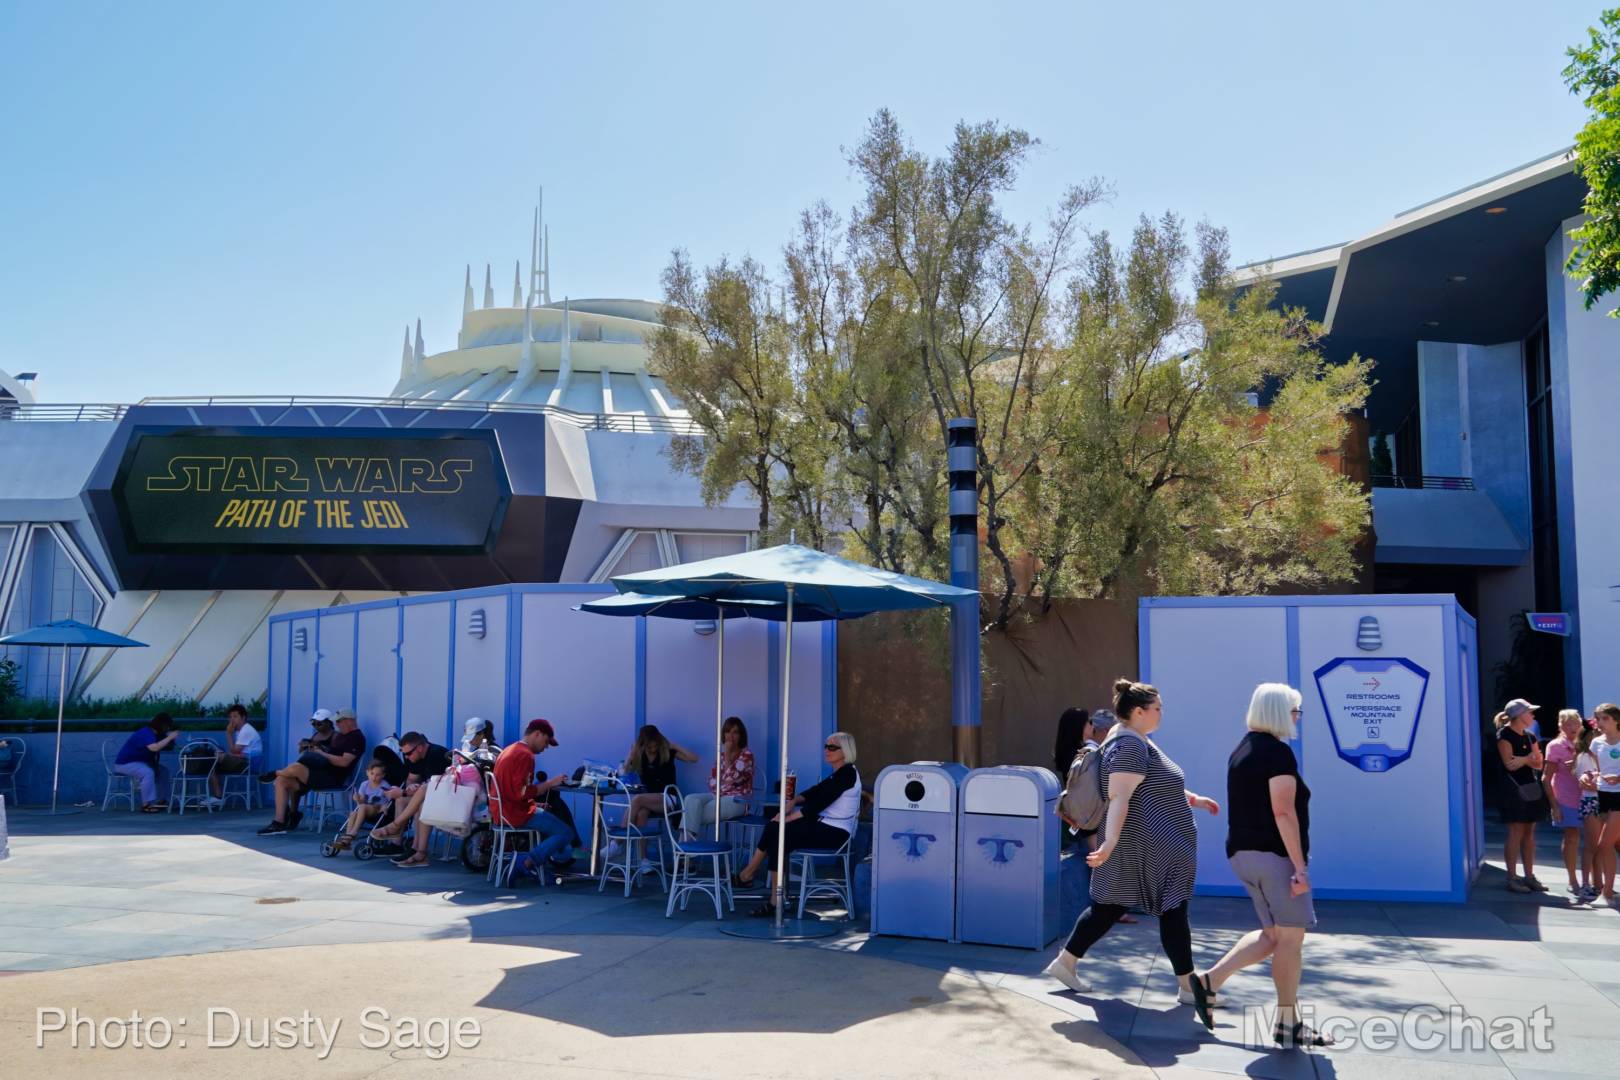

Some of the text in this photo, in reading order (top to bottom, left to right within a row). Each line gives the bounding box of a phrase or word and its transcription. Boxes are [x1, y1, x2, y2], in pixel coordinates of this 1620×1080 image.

[147, 456, 473, 493] STAR WARS
[214, 500, 409, 529] PATH OF THE JEDI
